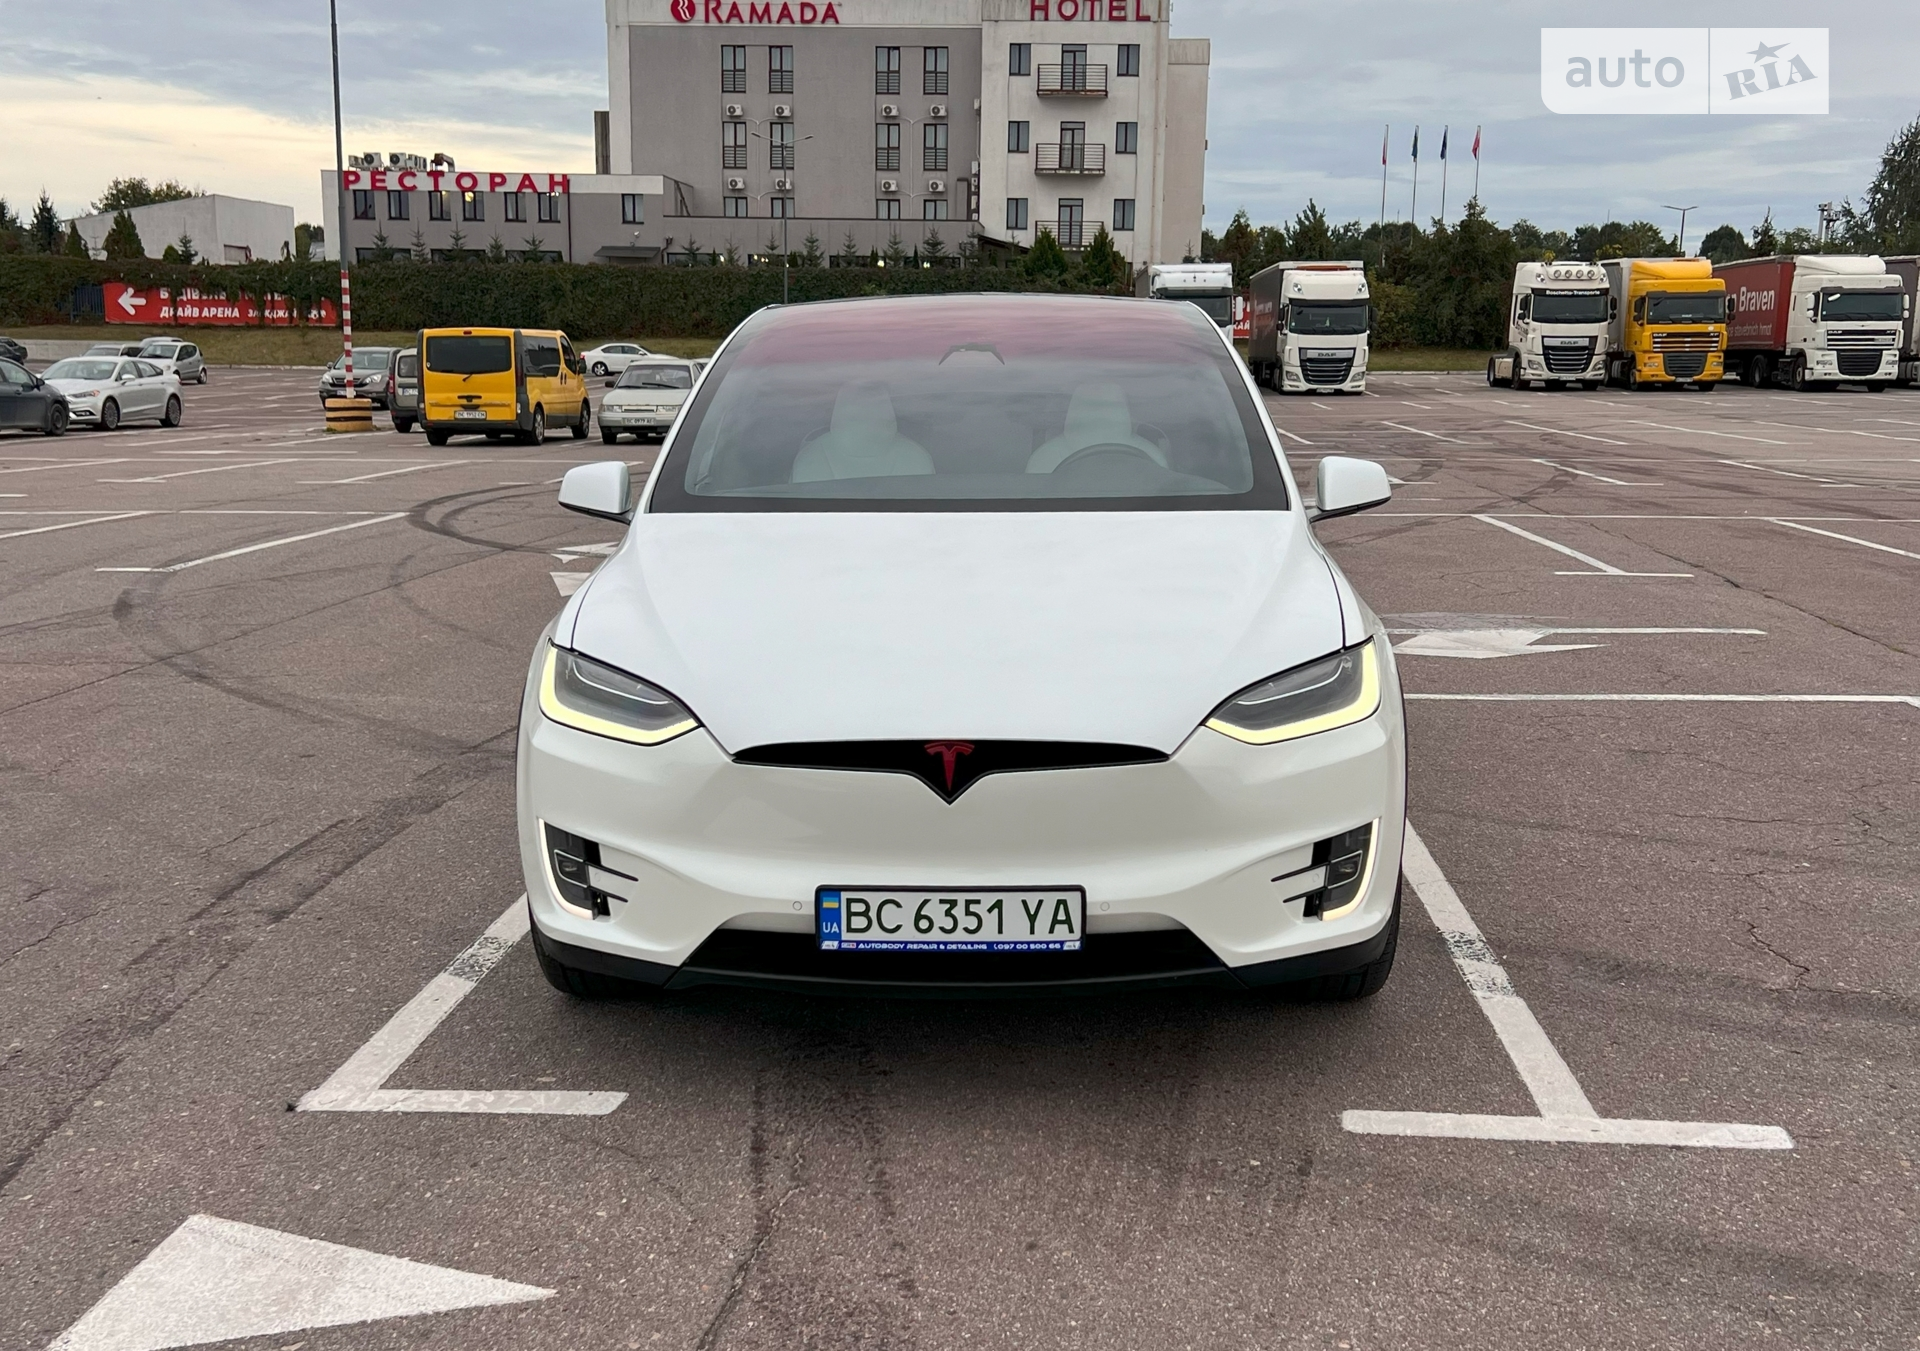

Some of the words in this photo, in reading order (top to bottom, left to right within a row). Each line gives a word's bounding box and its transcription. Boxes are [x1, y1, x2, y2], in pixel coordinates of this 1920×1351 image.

[704, 0, 840, 24] RAMADA
[1030, 0, 1151, 21] HOTEL
[343, 170, 569, 194] РЕСТОРАН
[1739, 286, 1775, 312] Braven
[201, 307, 240, 318] АРЕНА
[823, 922, 839, 933] UA
[846, 898, 904, 934] BC
[913, 898, 1003, 935] 6351
[1021, 898, 1075, 935] YA
